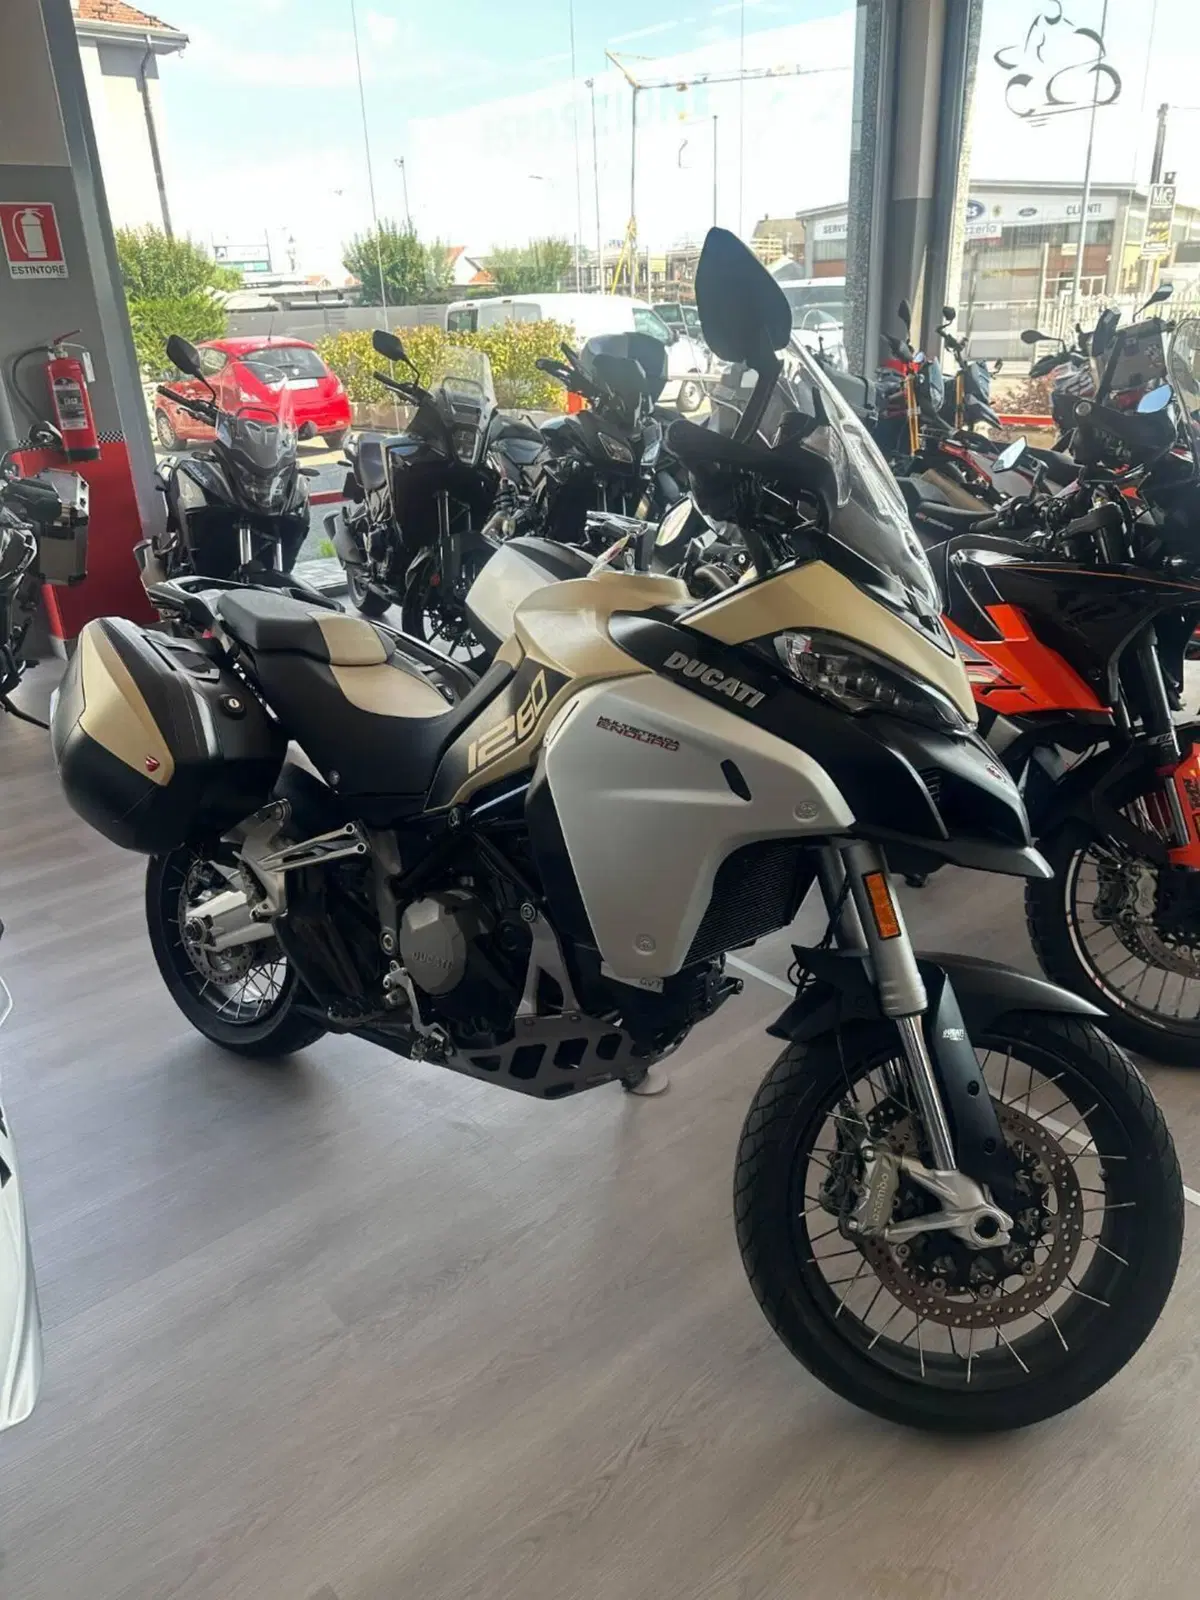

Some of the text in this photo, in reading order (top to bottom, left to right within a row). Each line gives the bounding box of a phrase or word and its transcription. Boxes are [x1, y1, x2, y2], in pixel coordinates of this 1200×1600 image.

[1066, 203, 1102, 215] CLINTI
[11, 265, 65, 275] ESTINTORE
[663, 651, 766, 708] DUCATI
[468, 668, 548, 774] 1260
[596, 720, 680, 751] ENDURO
